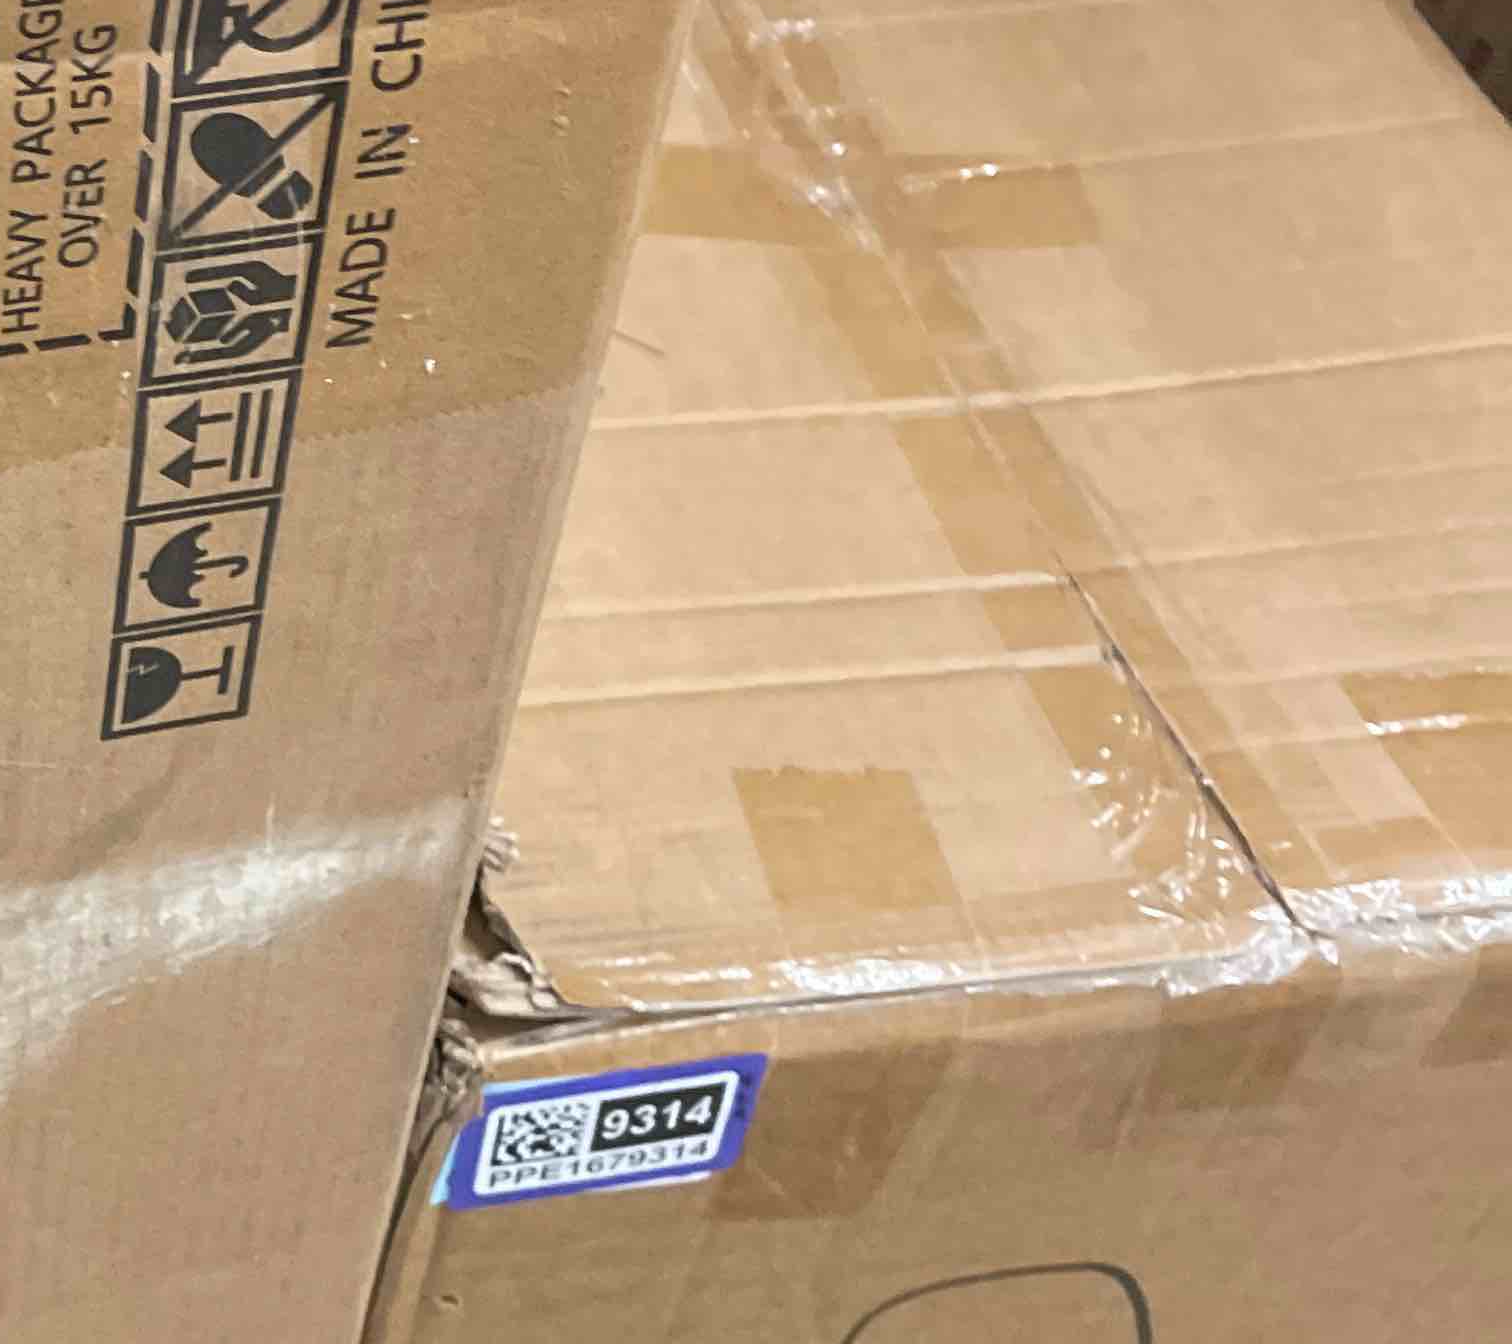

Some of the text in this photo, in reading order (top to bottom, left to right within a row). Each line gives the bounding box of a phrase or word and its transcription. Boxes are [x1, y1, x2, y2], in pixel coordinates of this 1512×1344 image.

[57, 23, 118, 268] OVER 15KG
[354, 123, 412, 179] IN
[2, 209, 49, 333] HEAVY
[325, 207, 396, 349] MADE
[601, 1094, 713, 1140] 9314
[489, 1141, 709, 1187] PPE1679314
